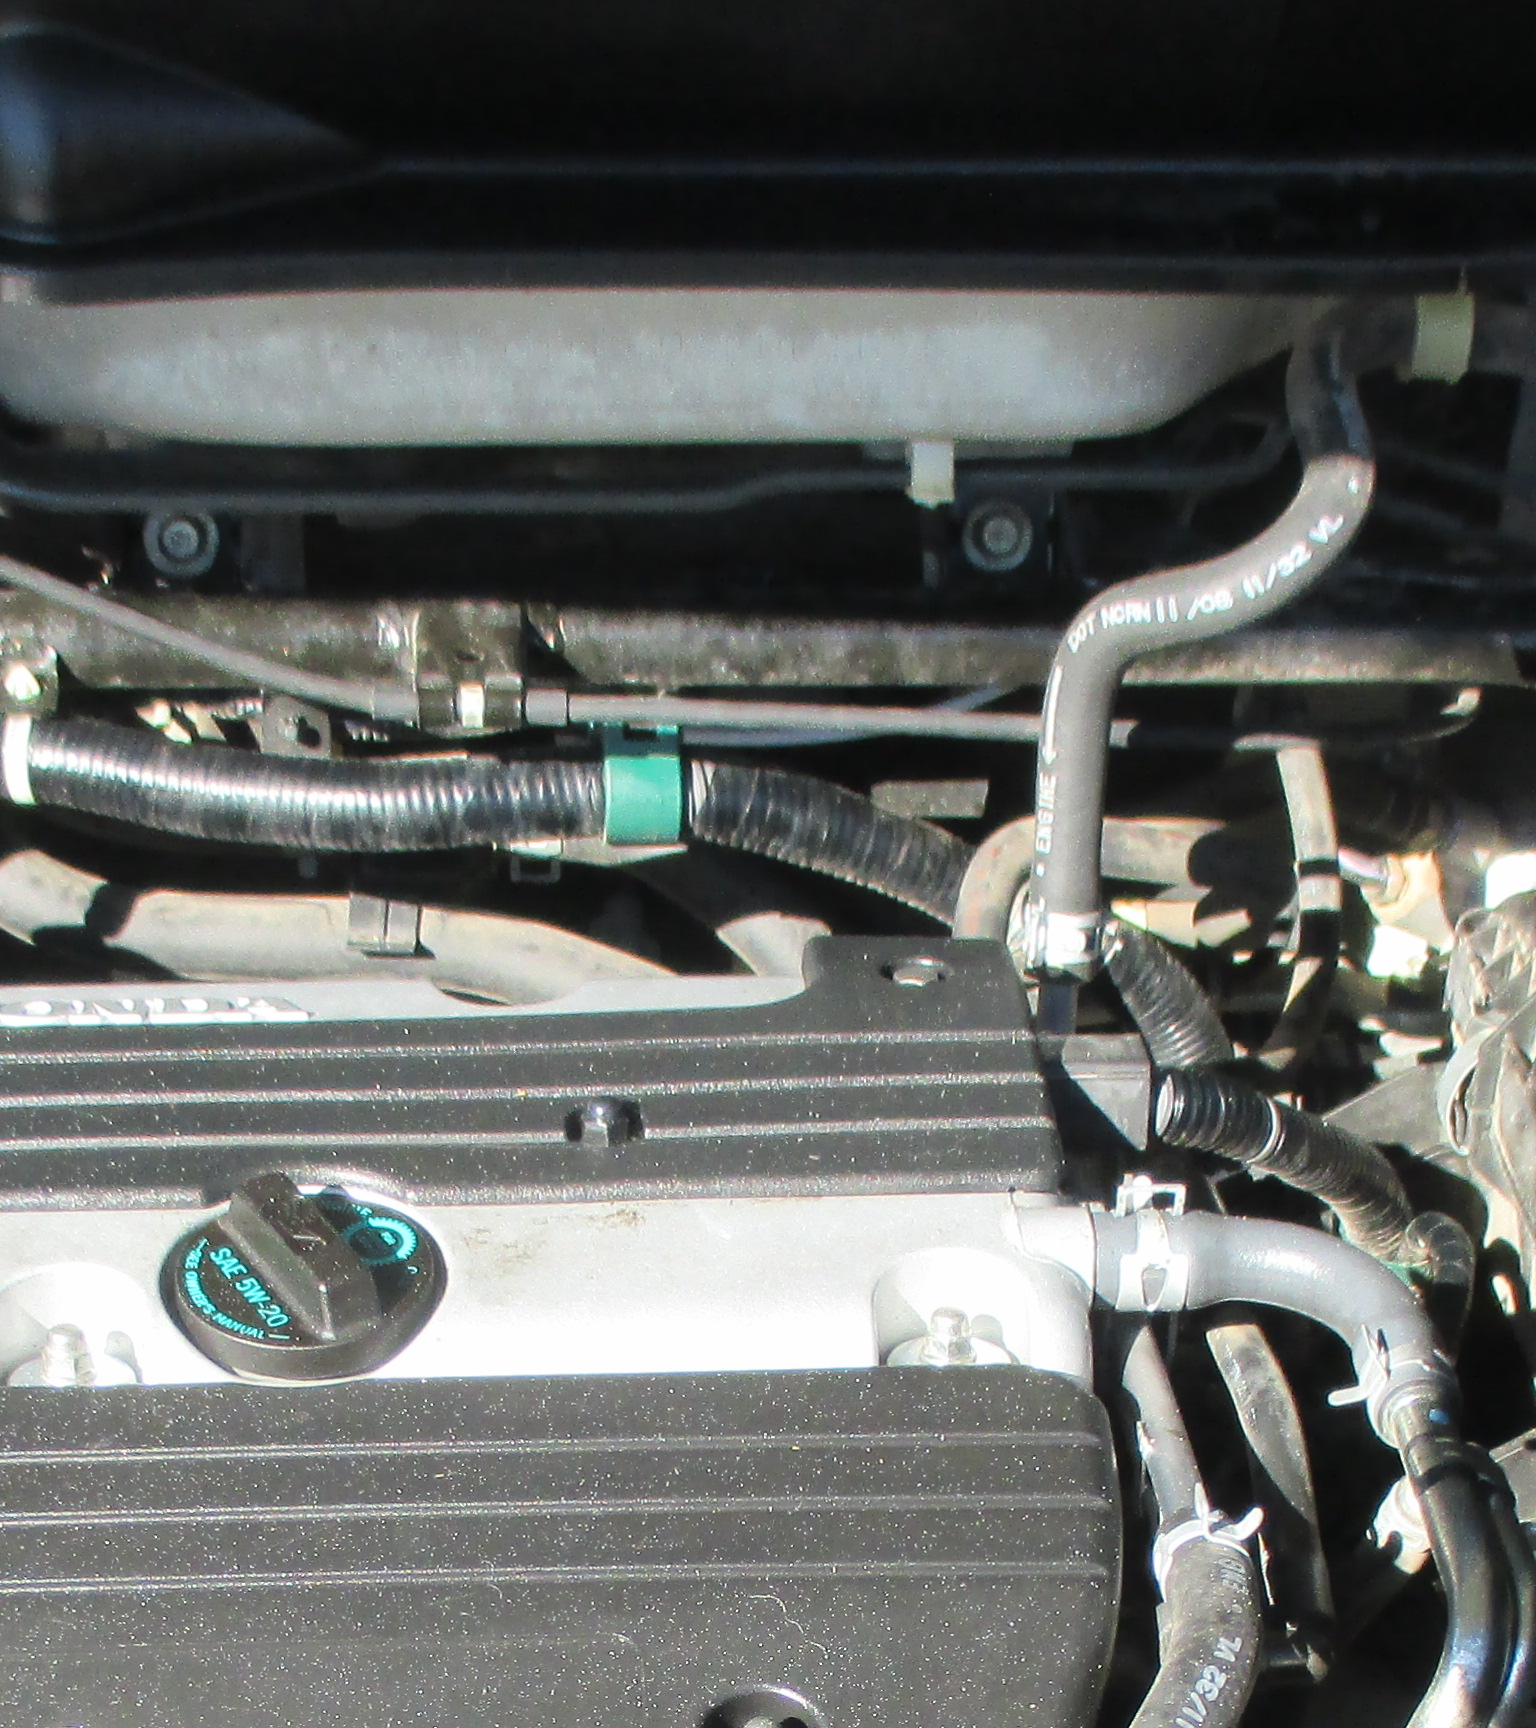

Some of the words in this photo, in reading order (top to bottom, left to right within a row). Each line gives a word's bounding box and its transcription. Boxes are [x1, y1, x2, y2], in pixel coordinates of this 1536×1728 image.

[1035, 770, 1057, 856] ENGINE
[208, 1246, 241, 1280] SAE
[235, 1273, 290, 1328] 5W-20
[212, 1311, 266, 1340] MANUAL
